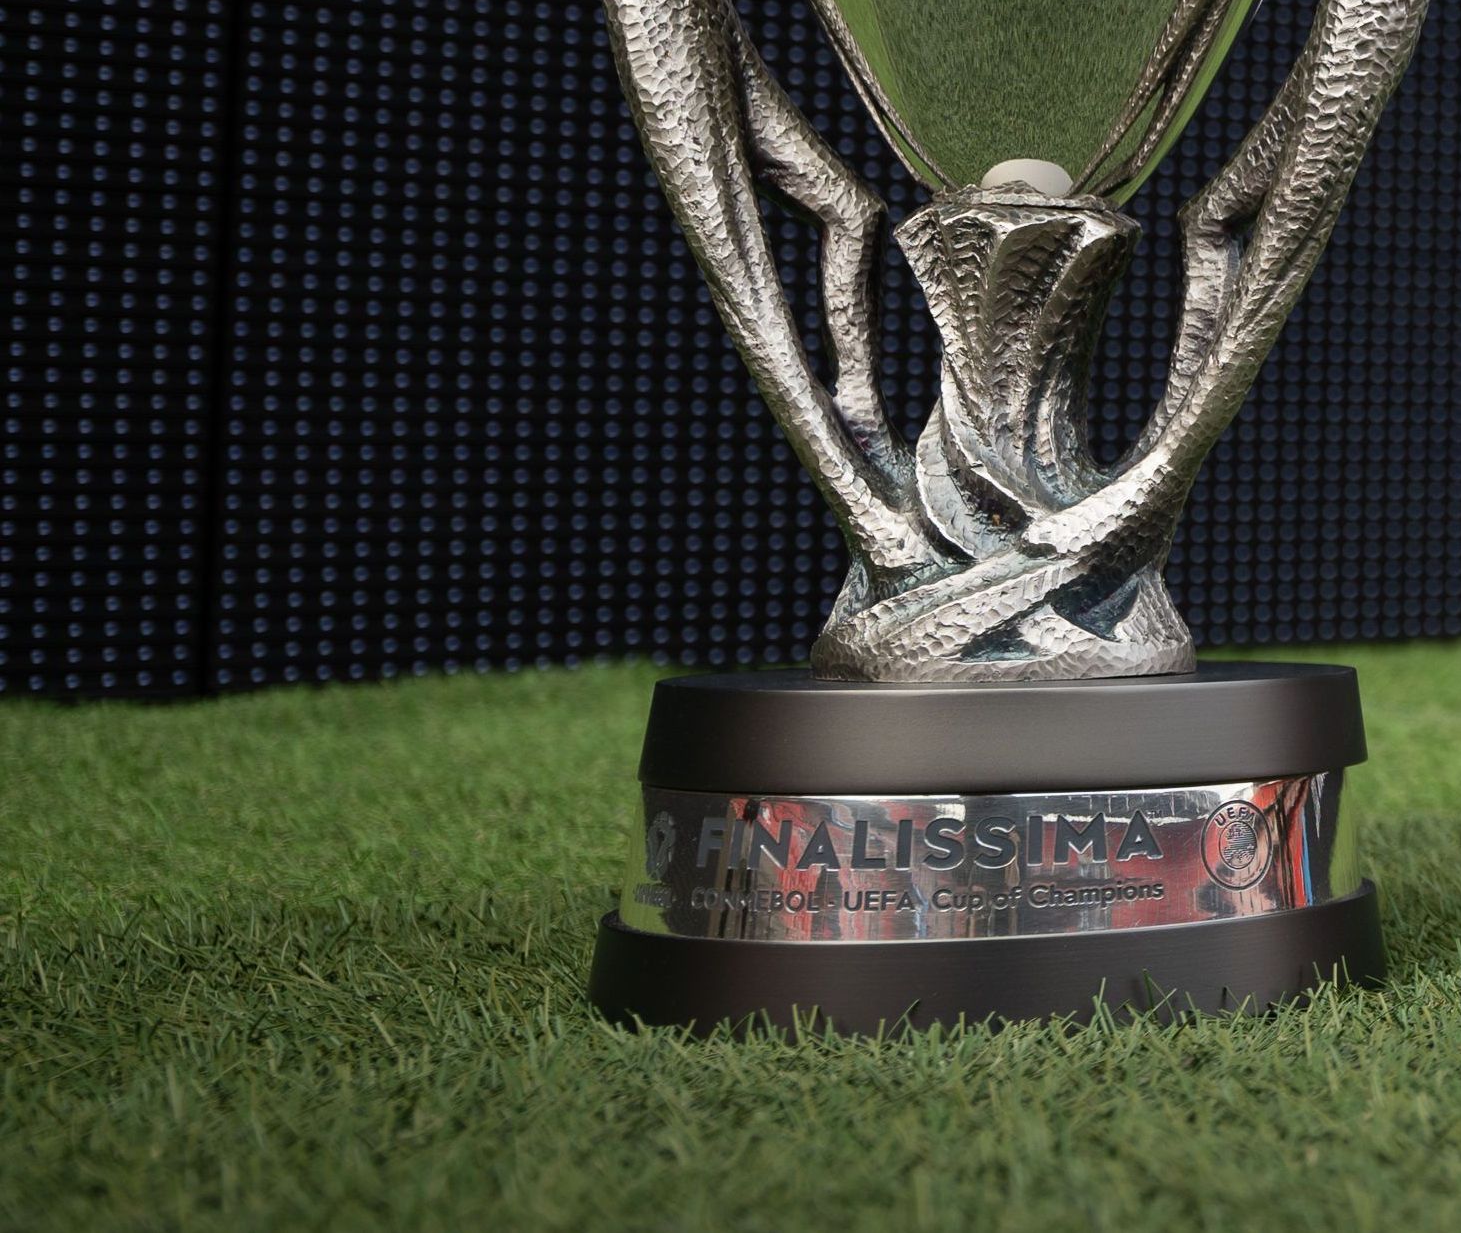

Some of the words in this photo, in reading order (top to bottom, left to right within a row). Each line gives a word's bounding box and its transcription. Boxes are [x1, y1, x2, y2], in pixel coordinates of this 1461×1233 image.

[1213, 806, 1257, 827] UEFA
[696, 809, 1164, 872] FINALISSIMA
[690, 886, 820, 913] CONMEBOL
[843, 891, 916, 913] UEFA
[931, 887, 985, 915] Cup
[991, 885, 1023, 911] of
[1027, 879, 1165, 911] Champions
